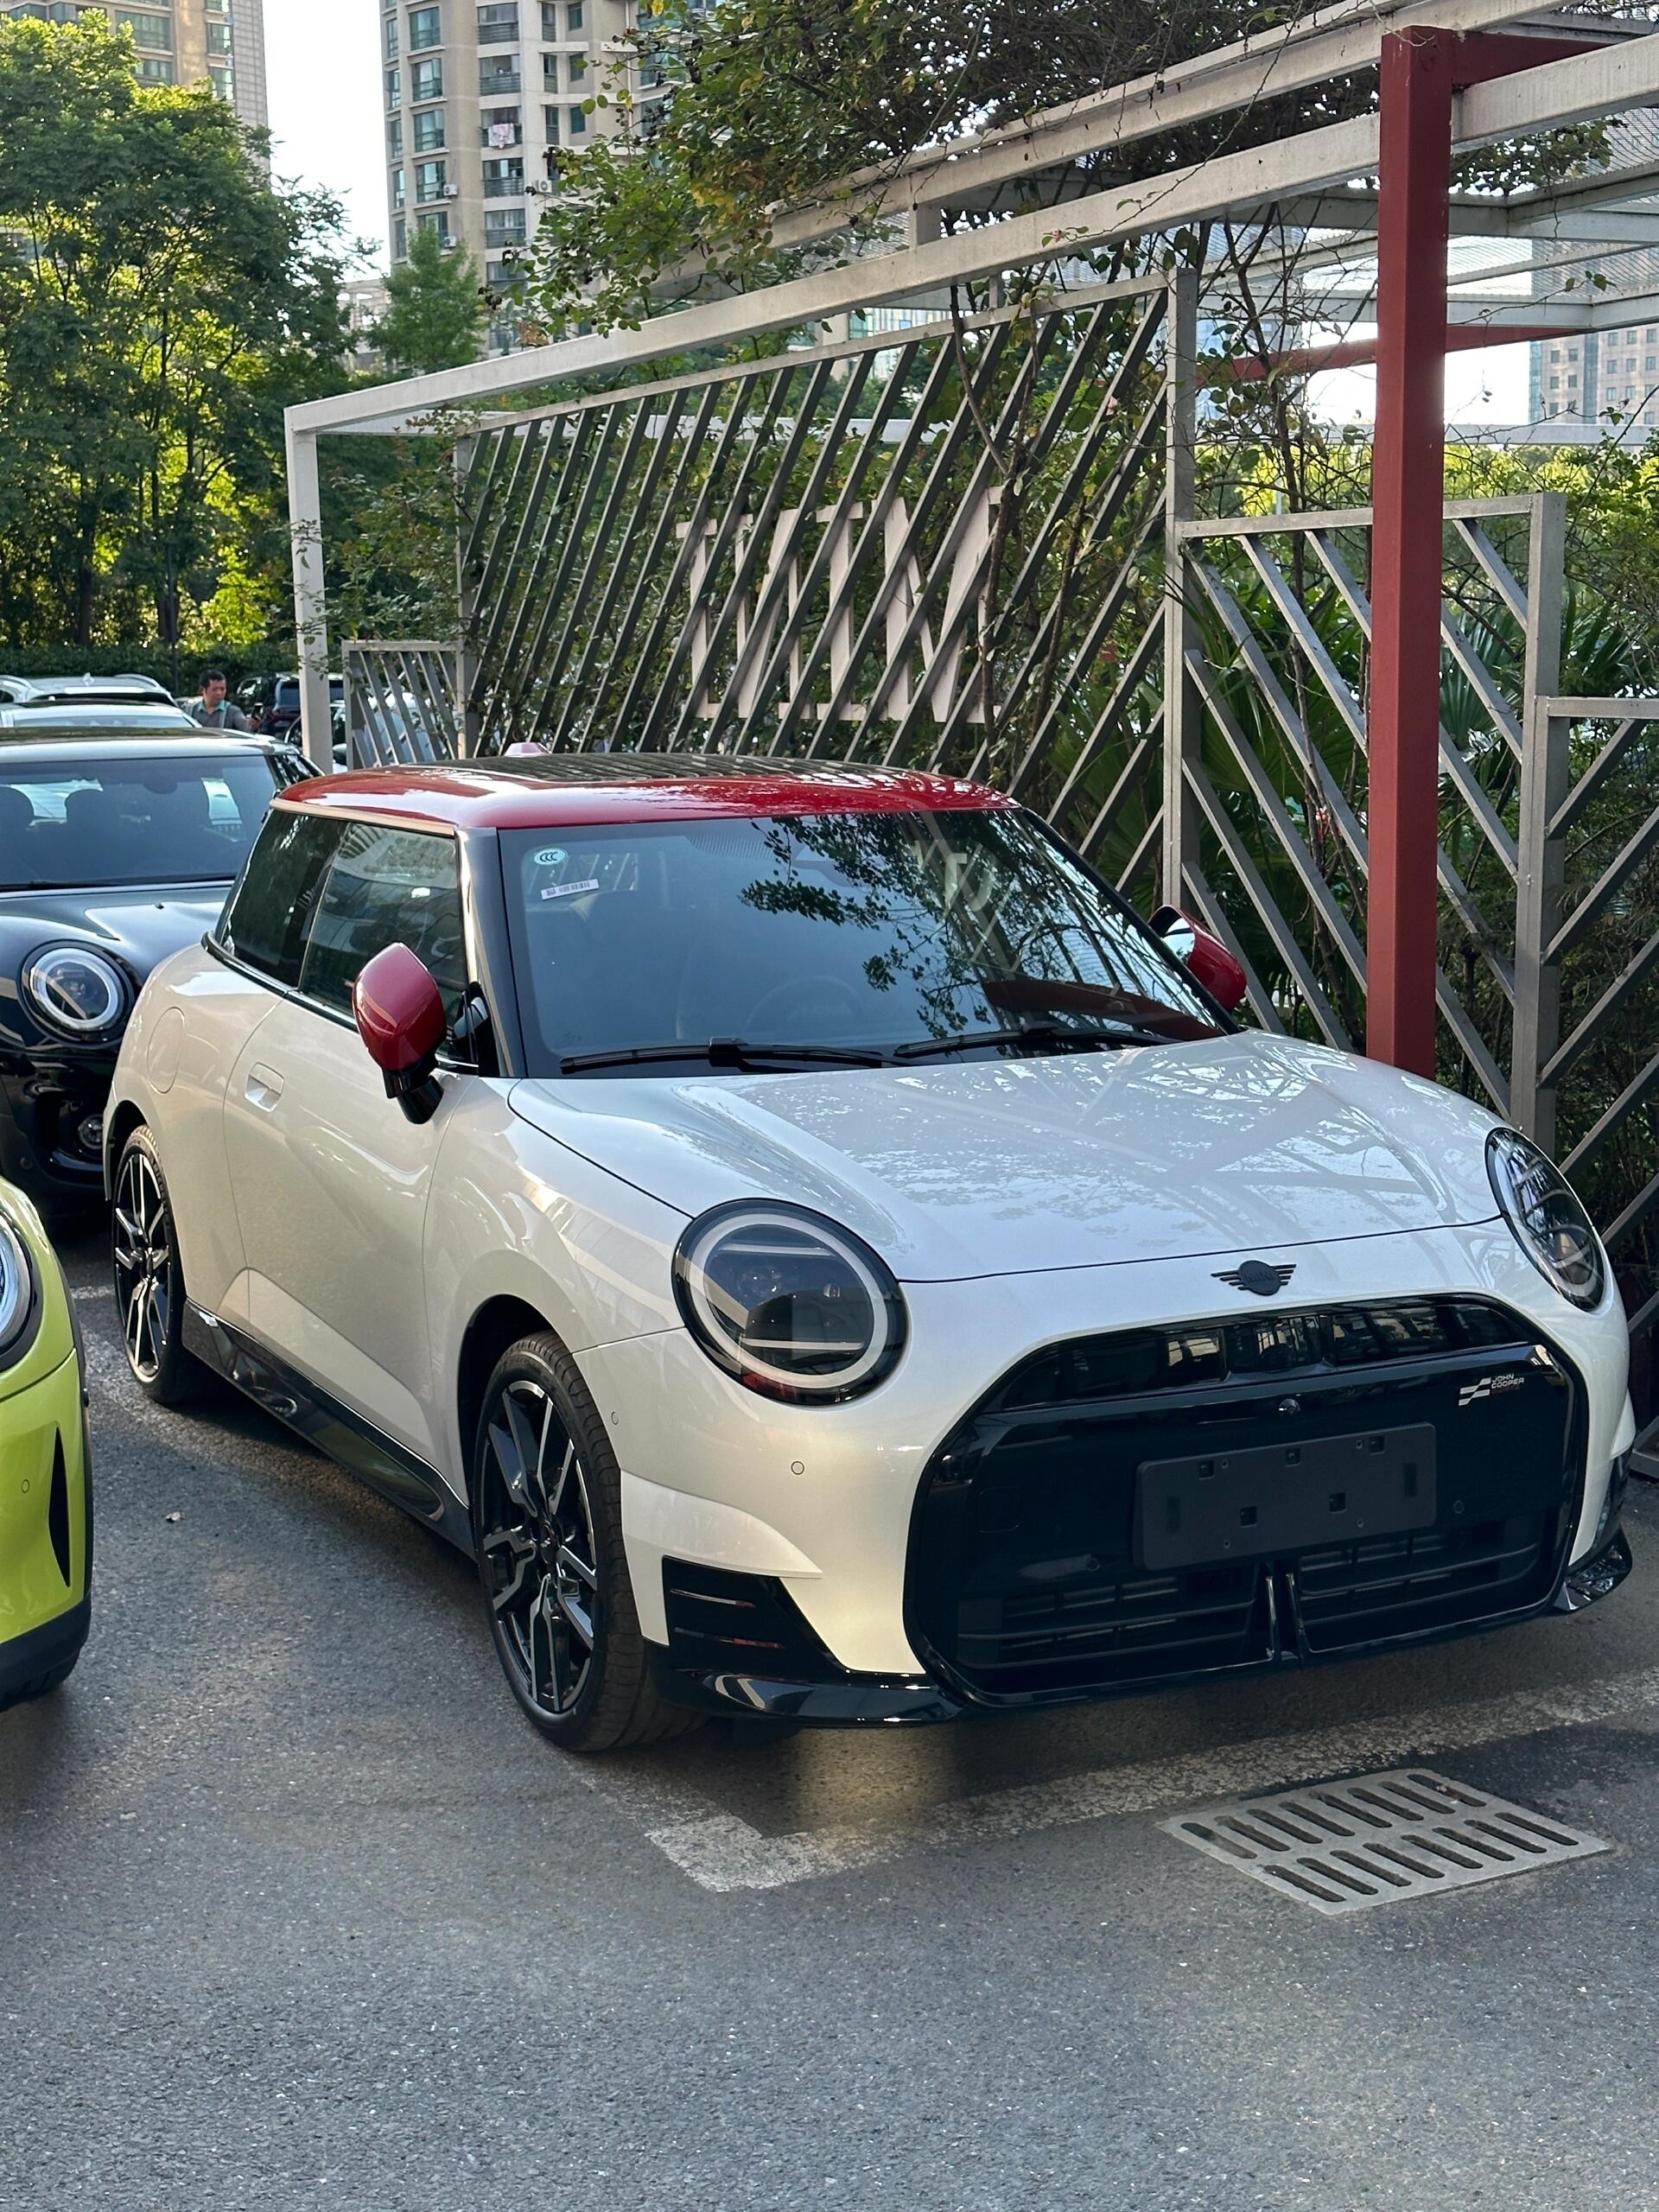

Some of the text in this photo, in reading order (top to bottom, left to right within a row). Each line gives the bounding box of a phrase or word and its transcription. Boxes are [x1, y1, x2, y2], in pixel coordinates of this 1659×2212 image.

[540, 851, 557, 862] CCC
[1491, 1373, 1515, 1383] JOHN
[1491, 1377, 1525, 1389] COOPER
